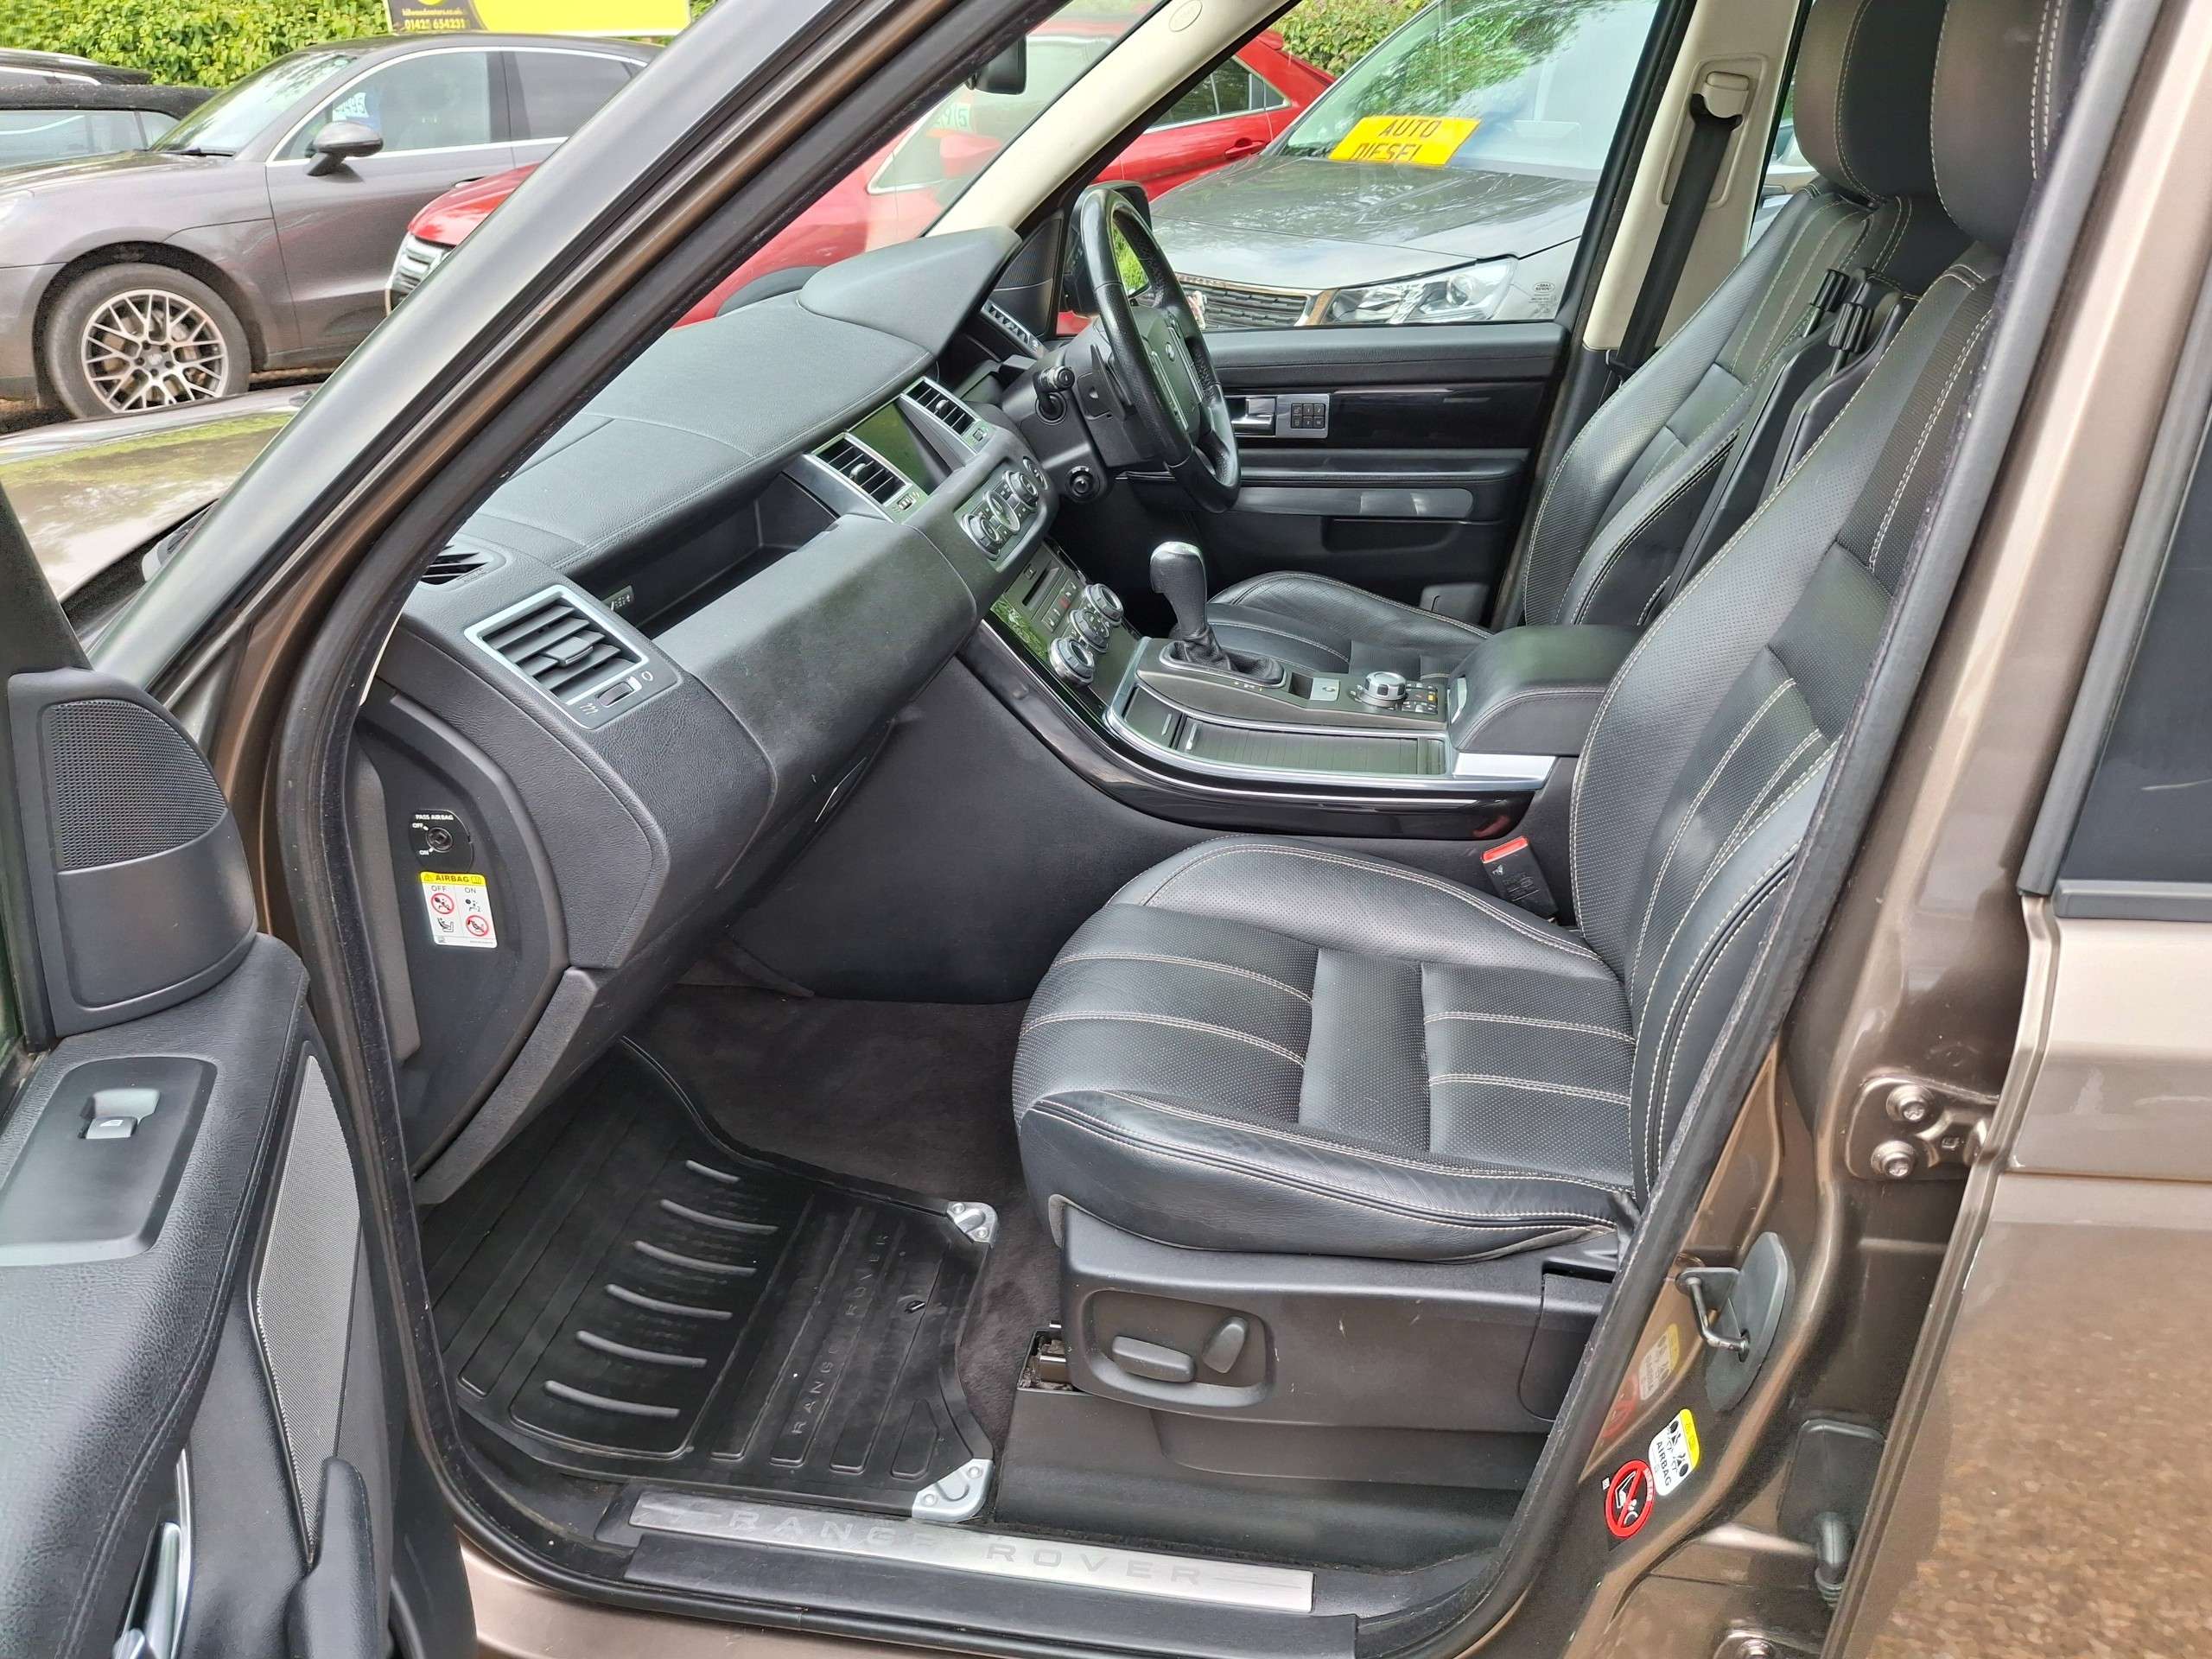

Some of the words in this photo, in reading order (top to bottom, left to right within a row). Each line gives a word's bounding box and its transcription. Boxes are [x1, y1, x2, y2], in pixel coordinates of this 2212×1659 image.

[1378, 119, 1442, 138] AUTO
[435, 874, 469, 883] AIRBAG
[1656, 1440, 1672, 1487] AIRBAG
[728, 1510, 936, 1548] RANGE
[986, 1541, 1201, 1586] ROVER
